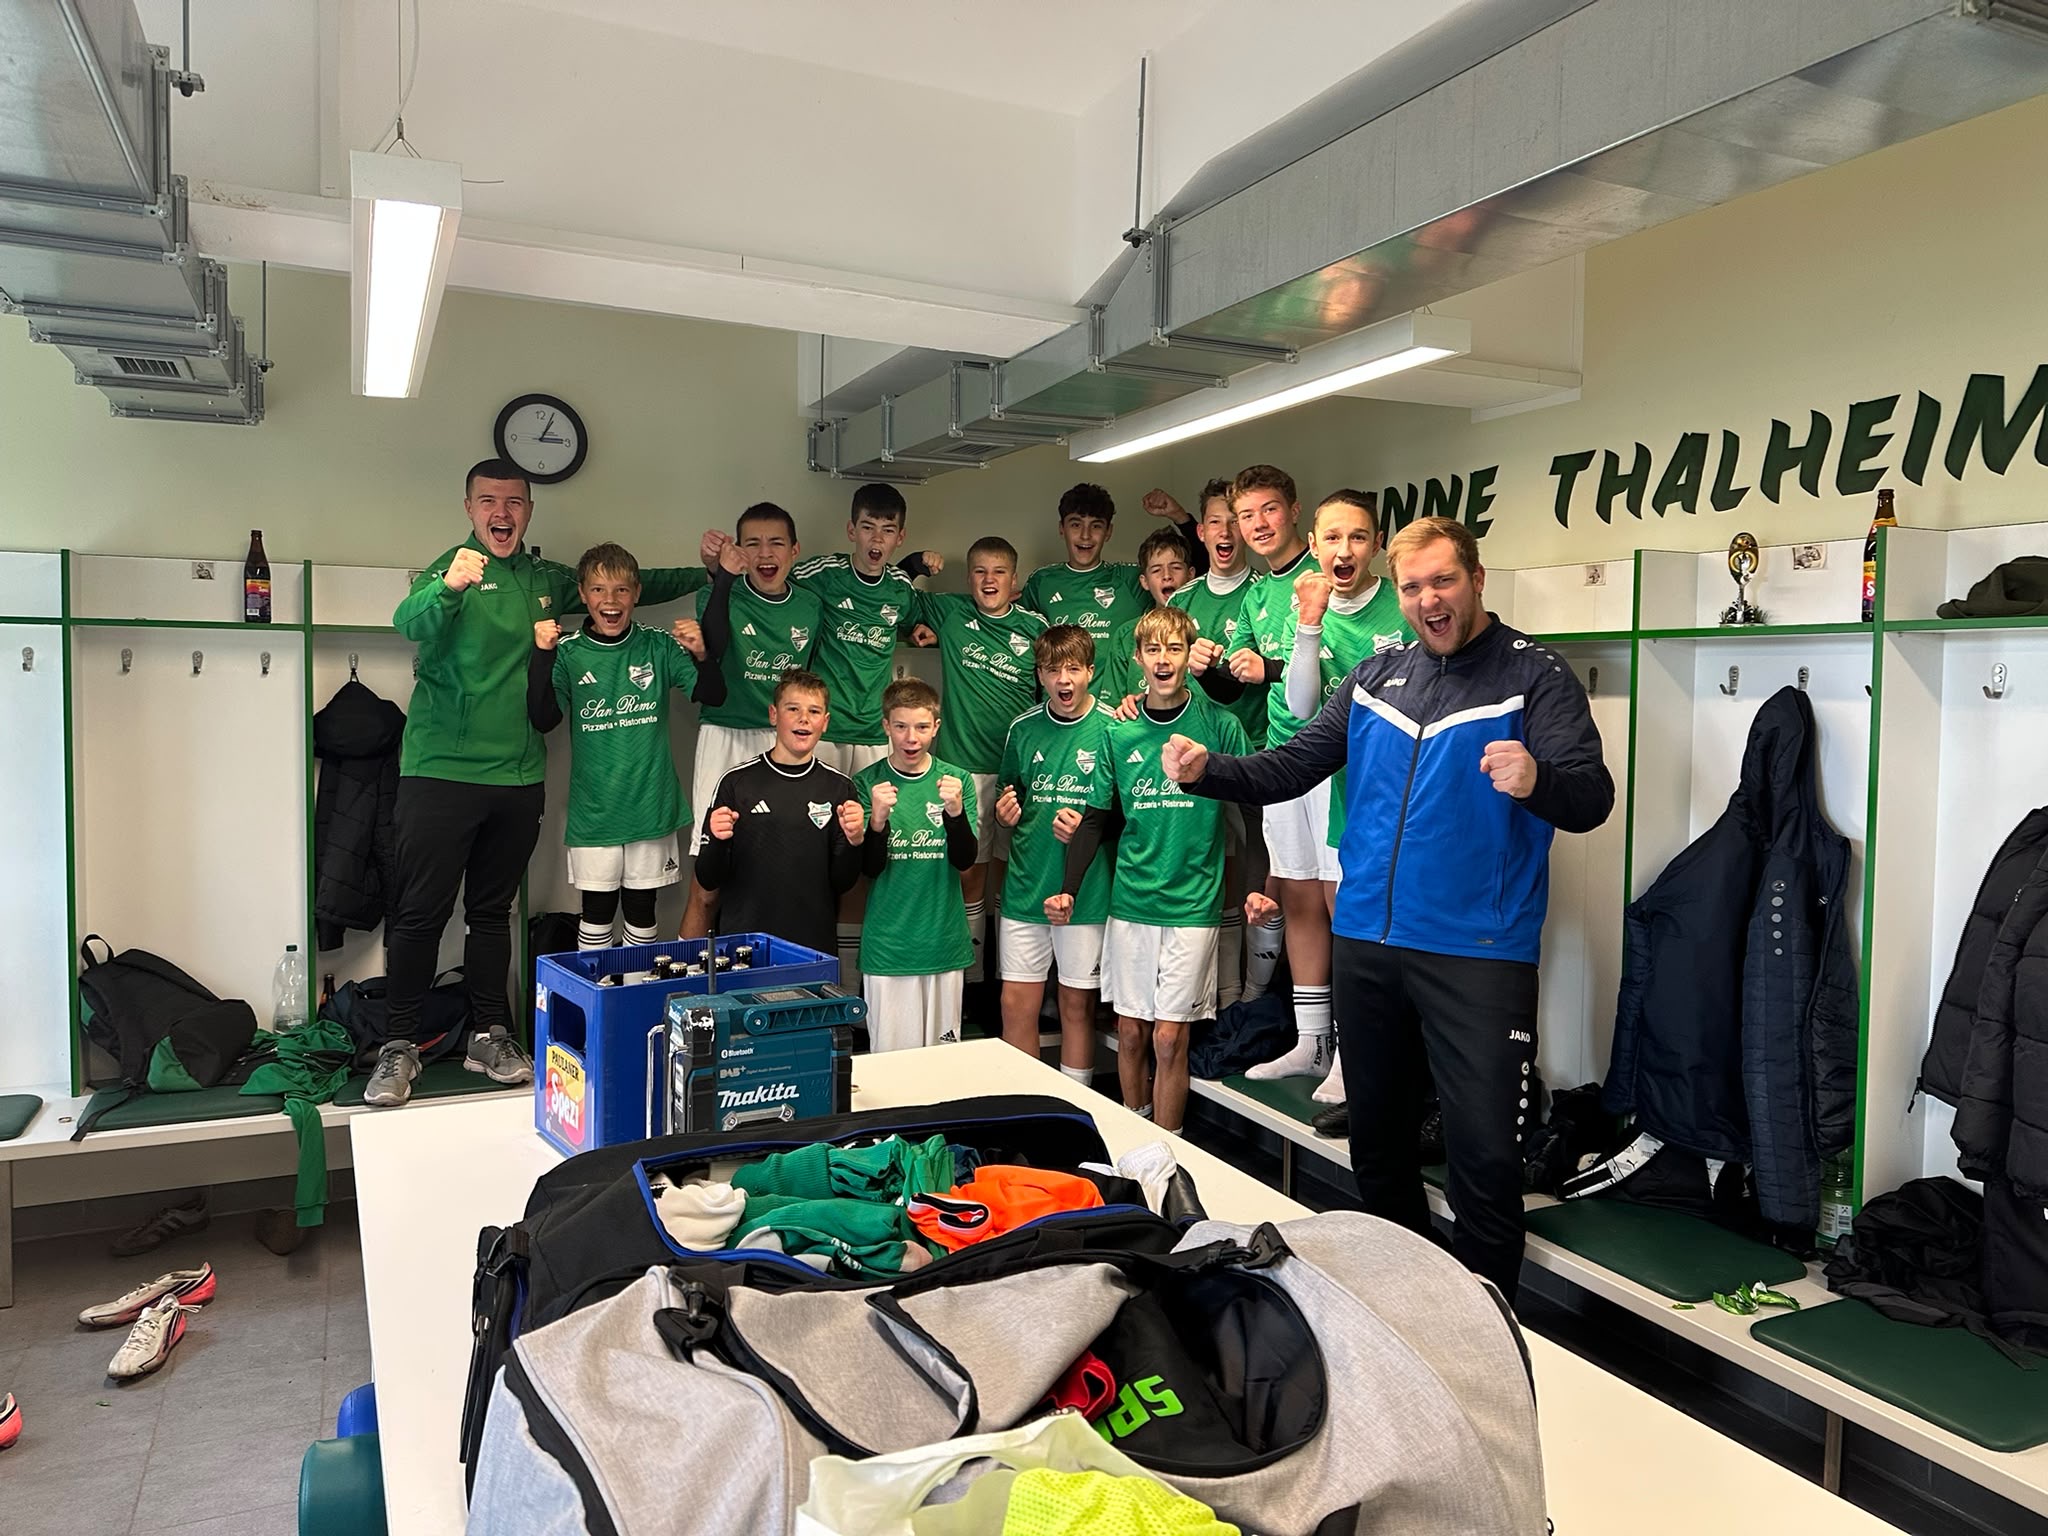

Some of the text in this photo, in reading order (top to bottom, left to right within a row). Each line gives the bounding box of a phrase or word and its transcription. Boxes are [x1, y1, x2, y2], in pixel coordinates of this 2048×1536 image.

[536, 410, 546, 420] 12
[510, 433, 518, 443] 9
[564, 438, 571, 448] 3
[1549, 364, 2048, 529] THALHEIM
[537, 461, 545, 470] 6
[746, 649, 770, 669] San
[962, 642, 1022, 675] San Remo
[580, 694, 657, 720] San Remo
[582, 715, 658, 732] Pizzeria Ristorante
[1056, 774, 1091, 794] Remo
[1131, 777, 1159, 798] San
[1509, 1029, 1531, 1043] JAKO
[551, 1050, 580, 1082] PAULANER
[551, 1072, 580, 1131] Spezi
